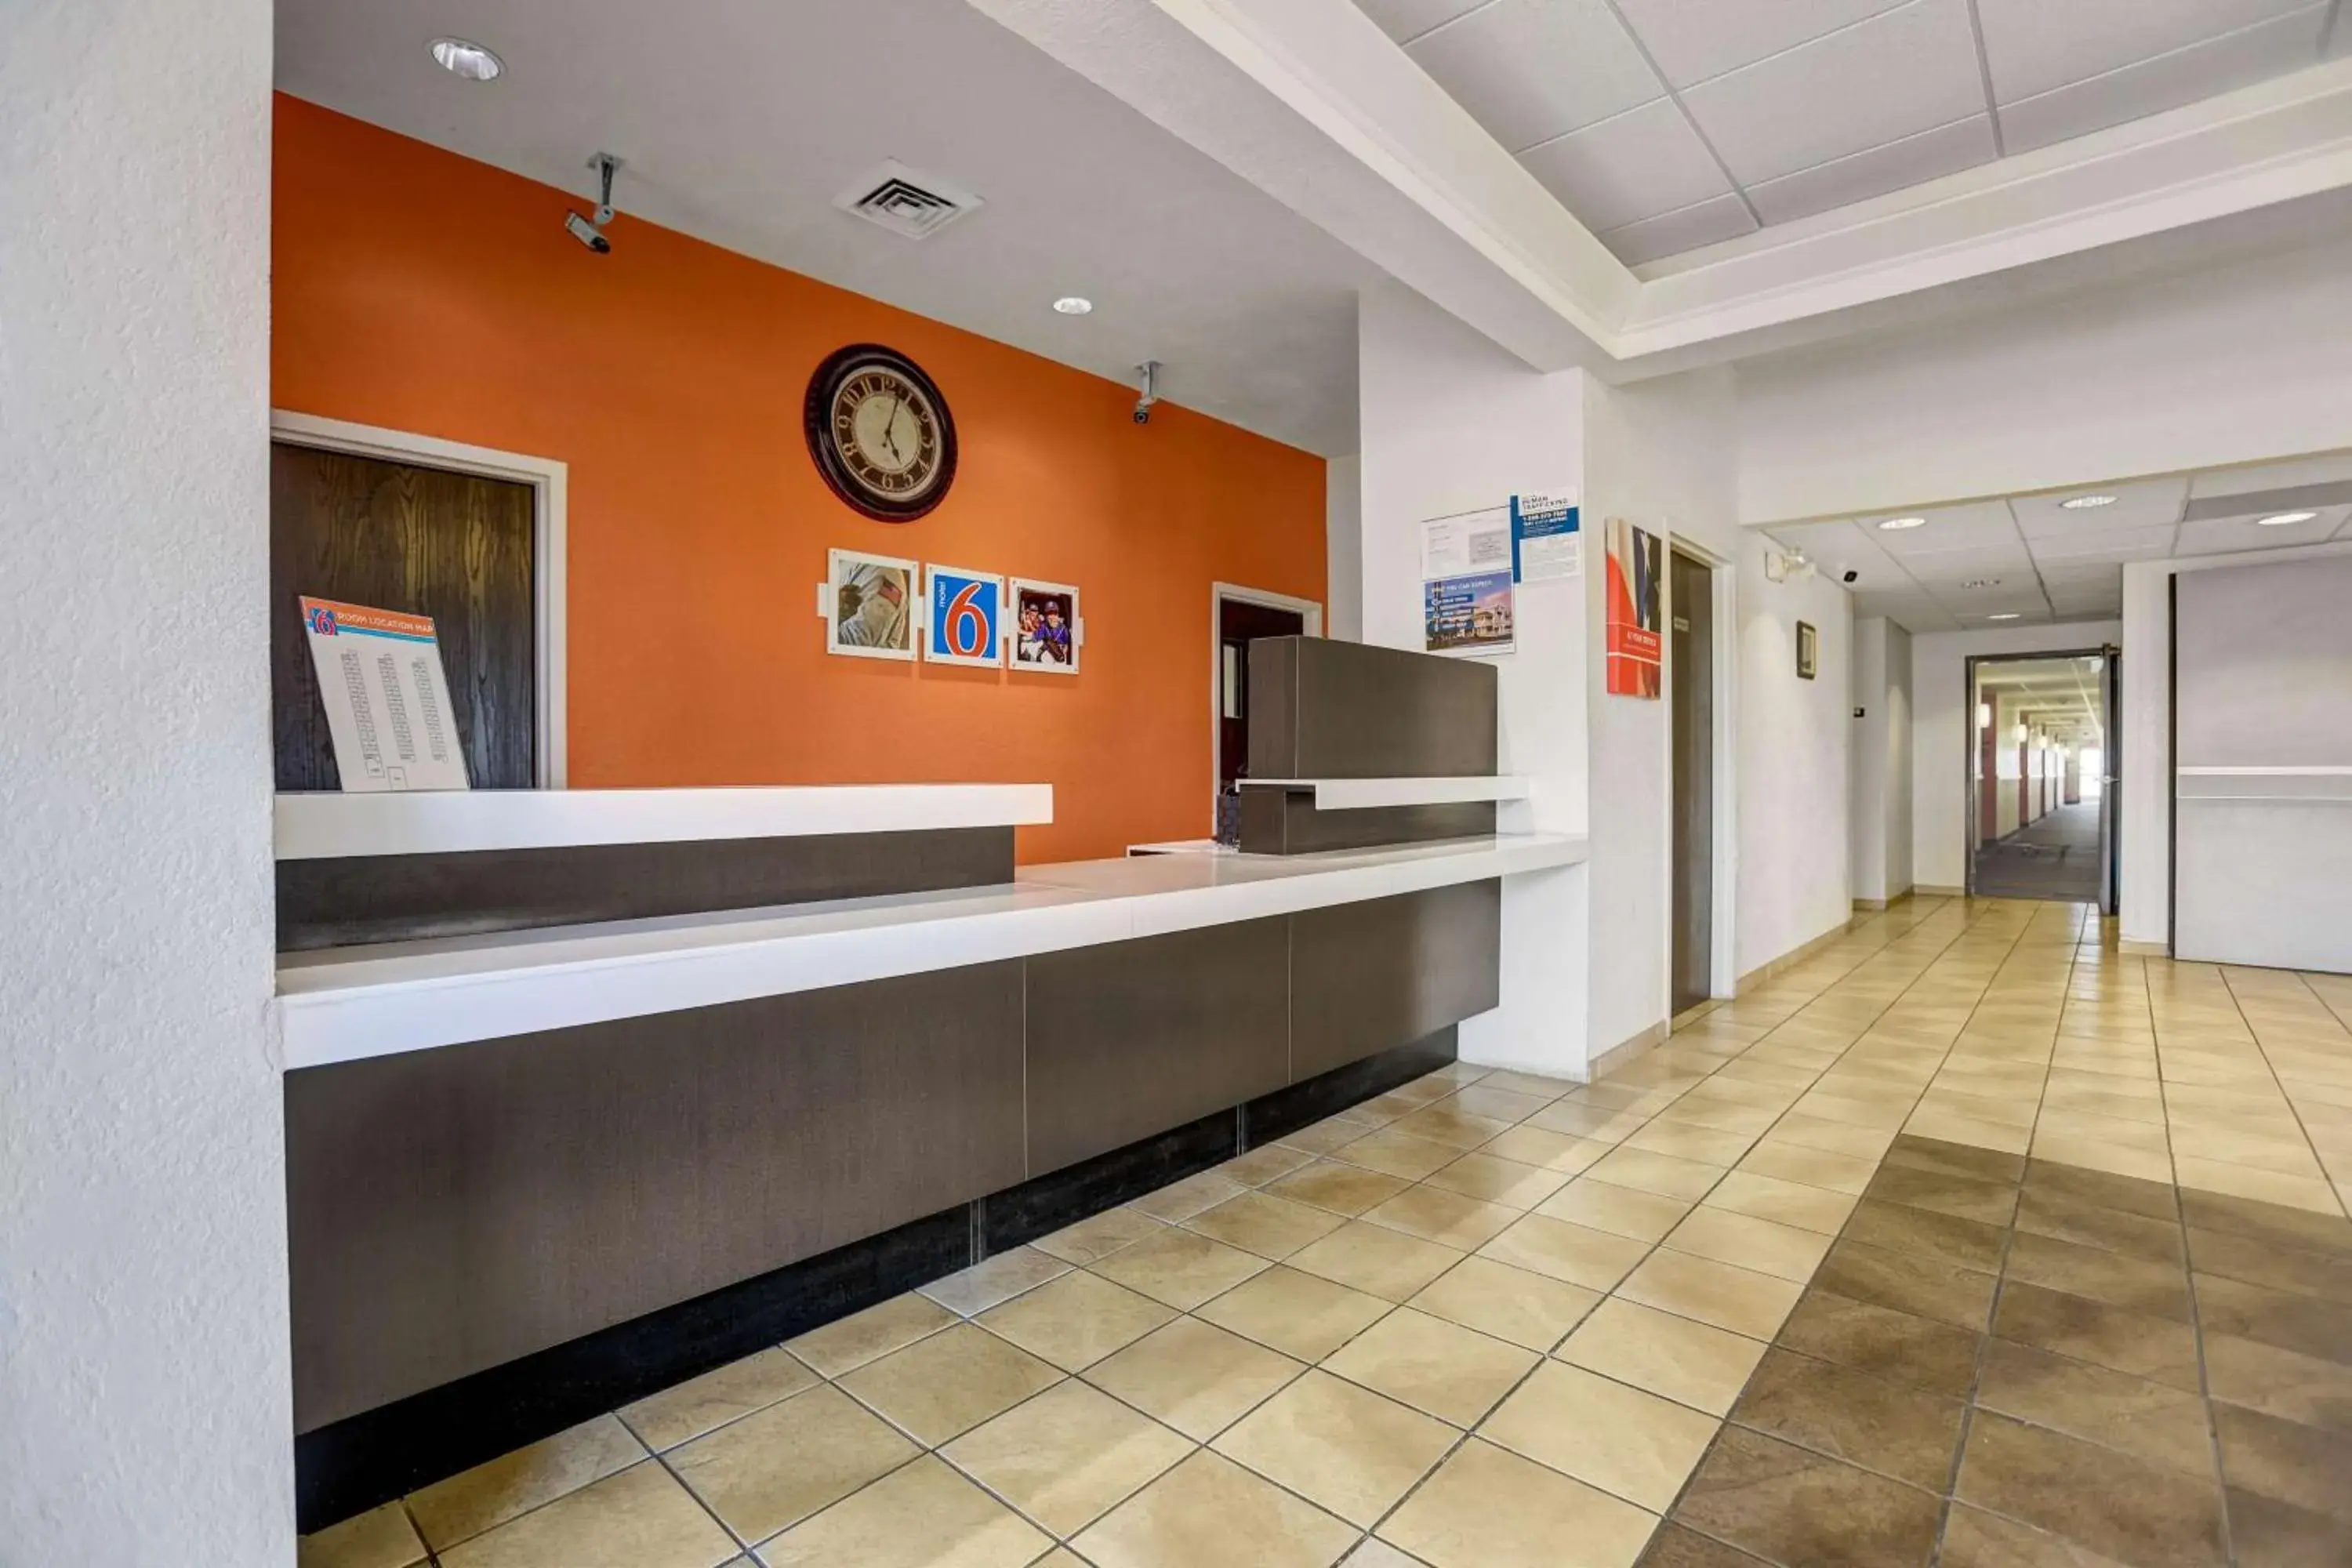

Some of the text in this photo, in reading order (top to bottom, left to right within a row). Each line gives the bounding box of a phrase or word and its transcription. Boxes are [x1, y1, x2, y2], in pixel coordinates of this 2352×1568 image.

[837, 415, 853, 429] 9
[843, 443, 858, 456] 8
[882, 474, 894, 490] 6
[944, 581, 989, 659] 6
